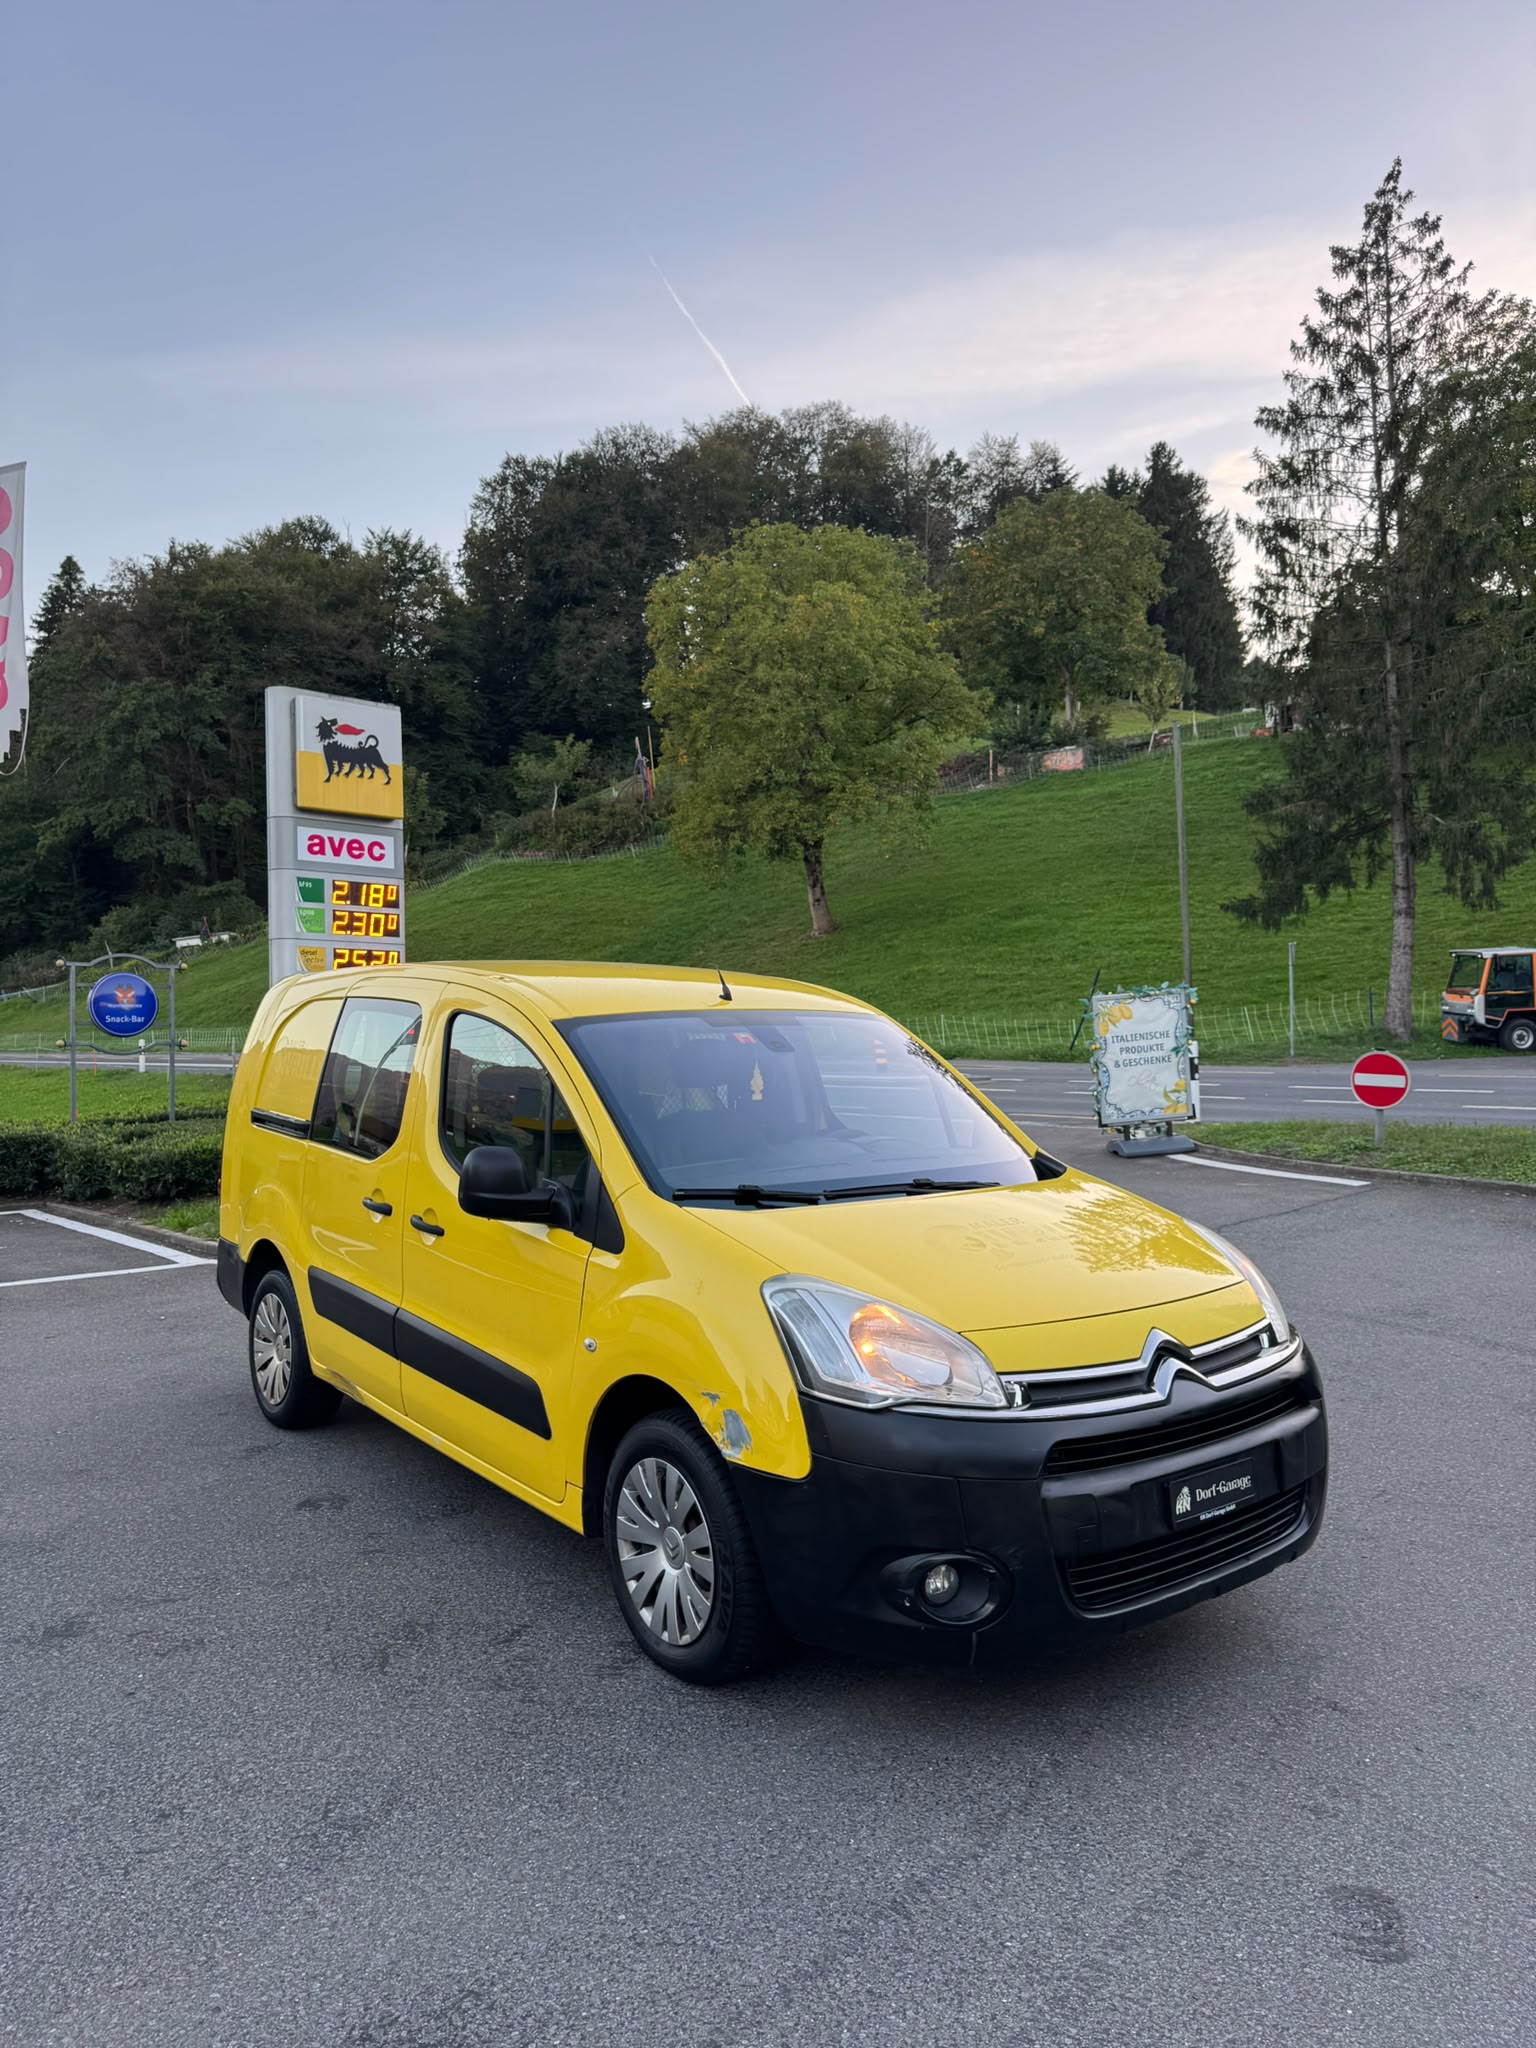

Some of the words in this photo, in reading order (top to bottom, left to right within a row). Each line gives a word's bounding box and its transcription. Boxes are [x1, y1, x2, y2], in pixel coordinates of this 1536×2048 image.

[306, 834, 386, 862] avec
[105, 1015, 145, 1023] Snack-Bar
[1111, 1030, 1171, 1044] ITALIENISCHE
[1119, 1043, 1165, 1056] PRODUKTE
[1113, 1060, 1122, 1069] &
[1122, 1055, 1172, 1068] GESCHENKE
[1195, 1475, 1252, 1502] Dorf-Garage
